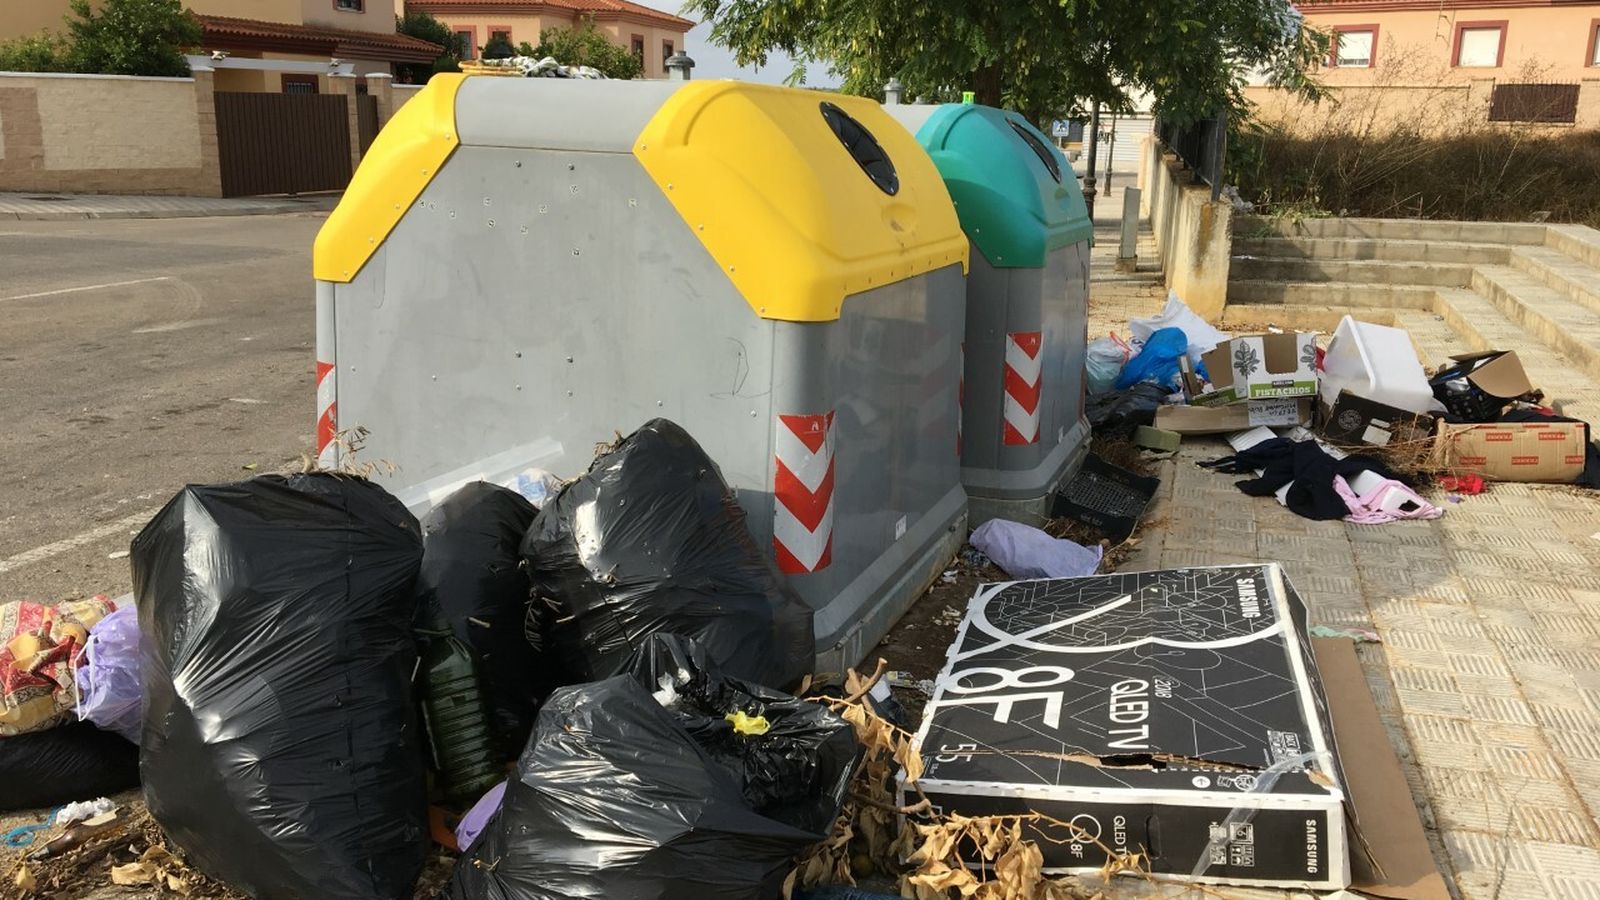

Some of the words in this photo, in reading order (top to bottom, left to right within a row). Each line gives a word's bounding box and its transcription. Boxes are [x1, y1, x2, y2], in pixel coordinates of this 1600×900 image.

[1255, 386, 1311, 397] PISTACHIOS
[1236, 577, 1261, 618] SAMSUNG
[1109, 679, 1150, 723] QLED
[1154, 678, 1172, 698] 2018
[1107, 725, 1150, 750] TV
[935, 743, 977, 763] 55
[1113, 815, 1126, 845] QLED
[1305, 819, 1318, 874] SAMSUNG
